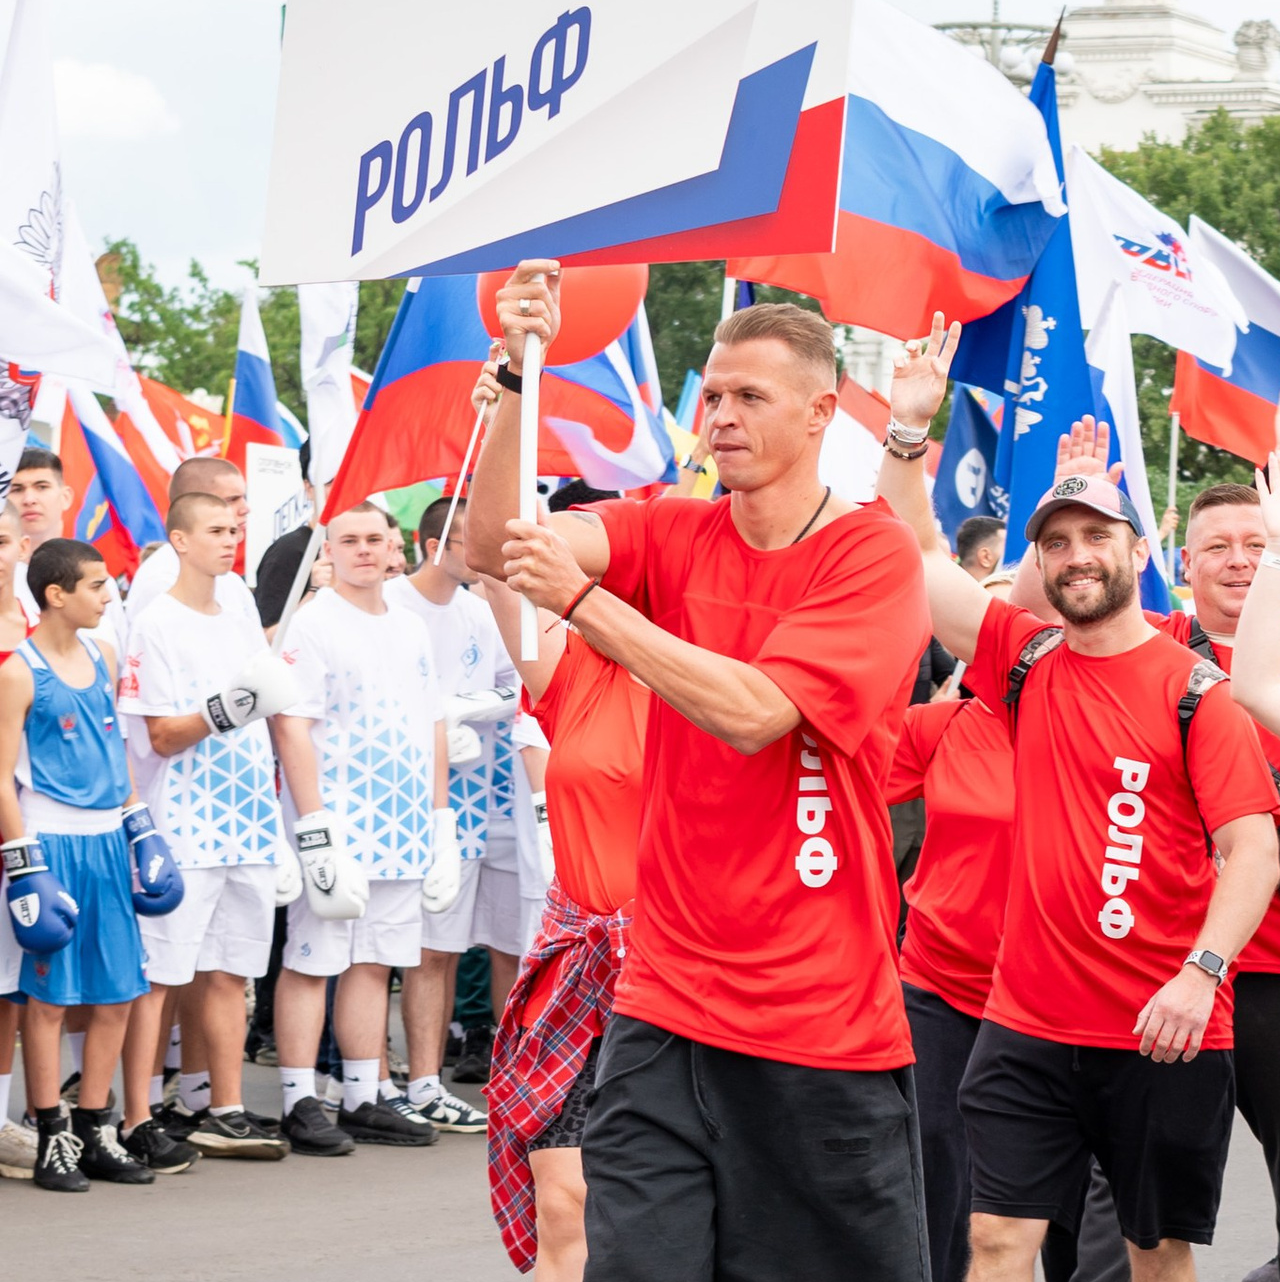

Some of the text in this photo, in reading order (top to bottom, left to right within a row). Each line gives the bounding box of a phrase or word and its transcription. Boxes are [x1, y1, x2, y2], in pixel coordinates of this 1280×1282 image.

[351, 6, 592, 258] РОЛЬФ
[795, 733, 838, 888] ЛЬФ
[1098, 756, 1151, 939] РОЛЬФ
